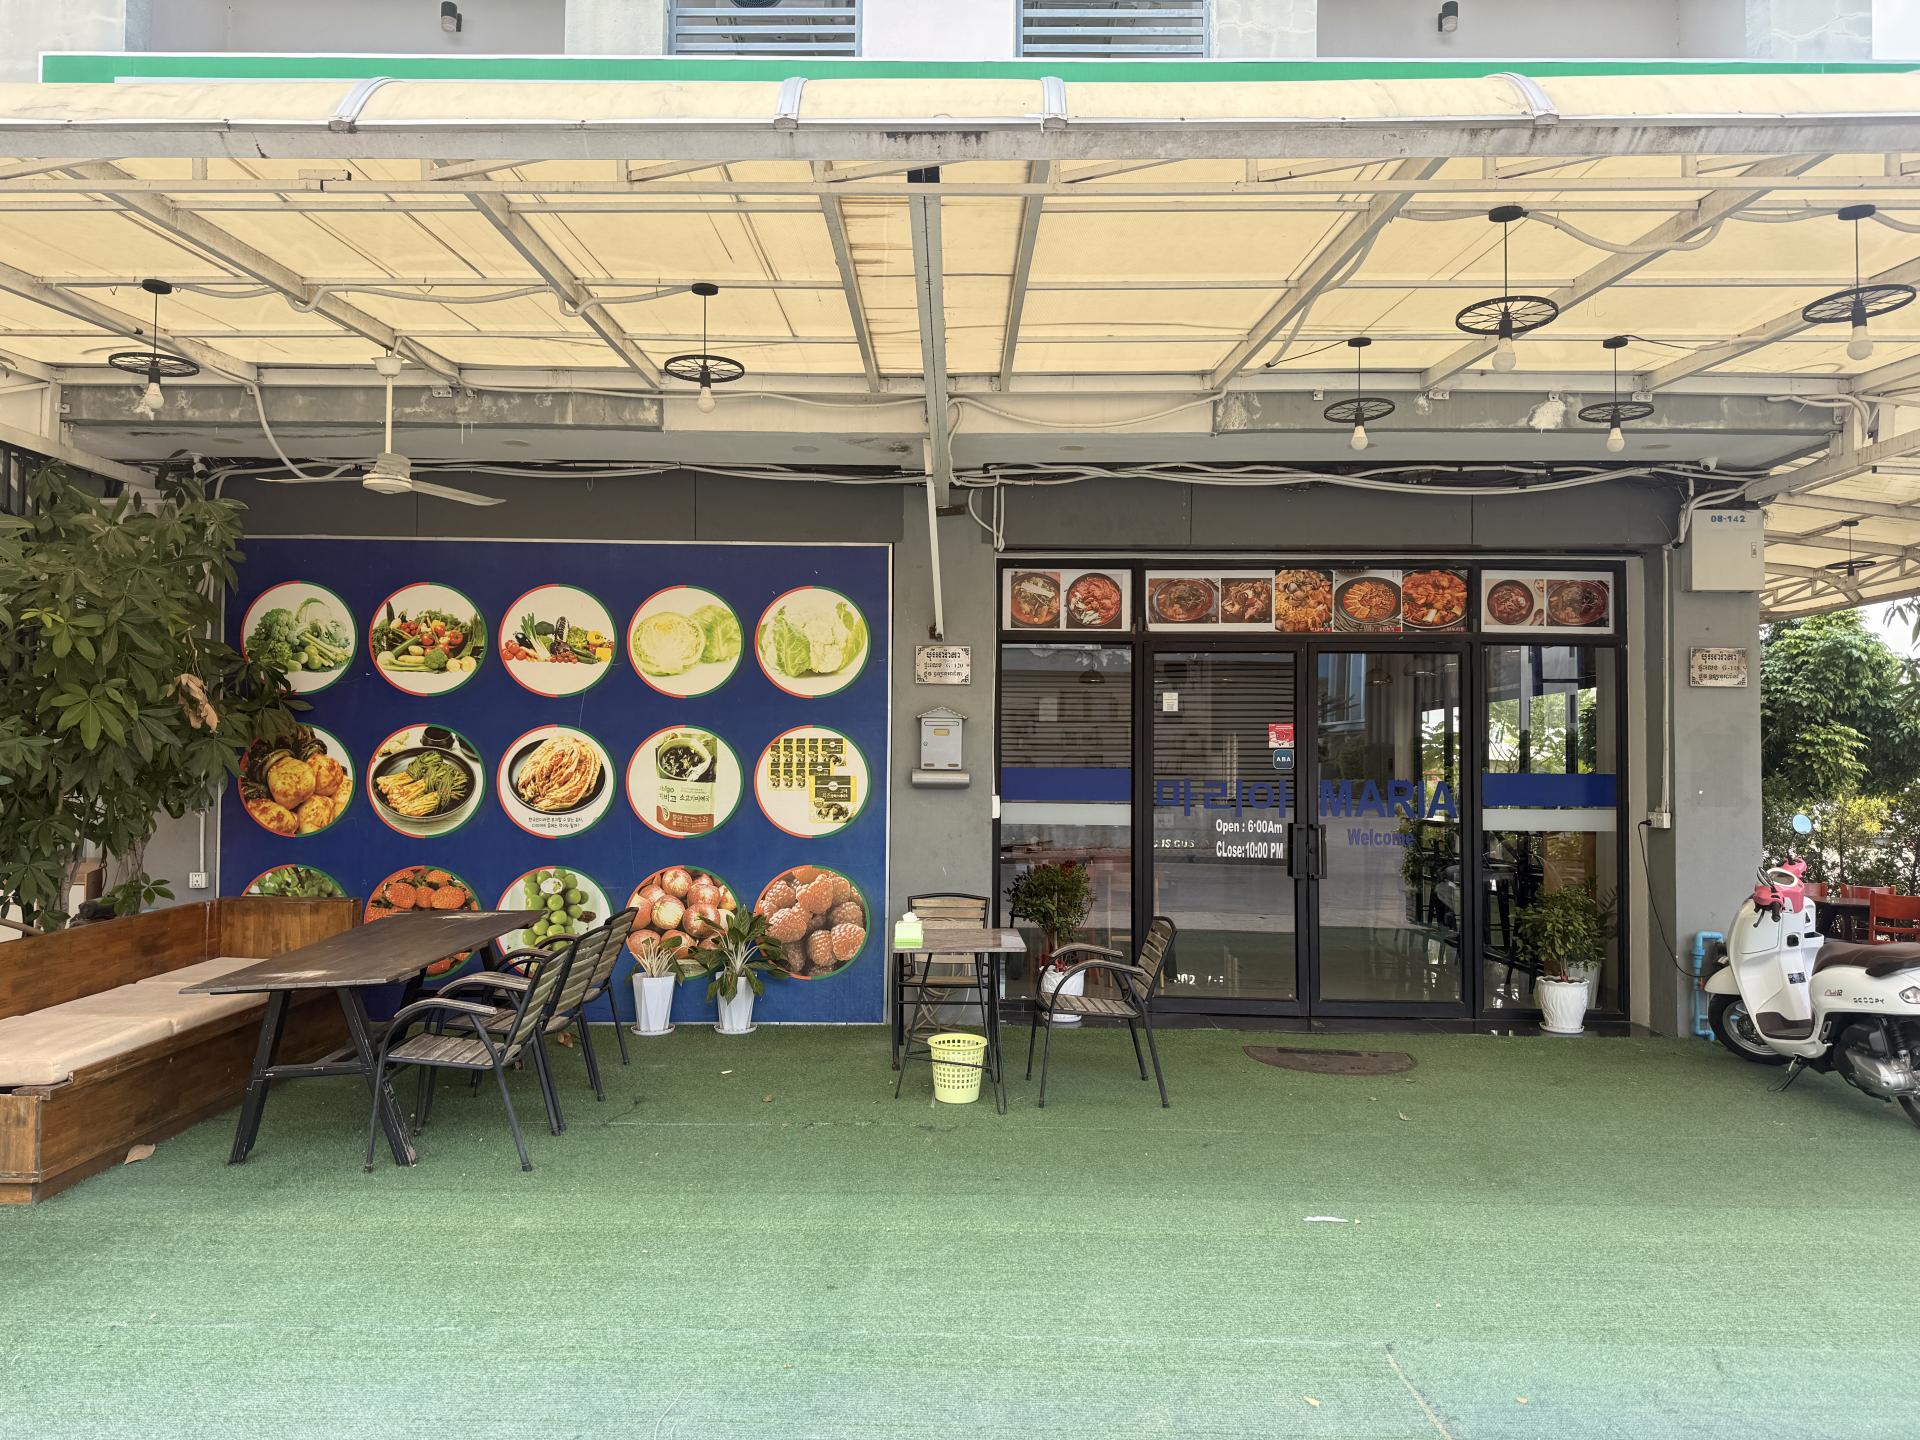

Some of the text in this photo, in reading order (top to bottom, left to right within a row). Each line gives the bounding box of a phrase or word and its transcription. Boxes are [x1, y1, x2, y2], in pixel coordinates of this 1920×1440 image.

[1711, 514, 1746, 523] 08-142
[1156, 778, 1287, 818] 마리아
[1319, 778, 1458, 819] MARIA
[1215, 818, 1240, 836] Open
[1346, 827, 1415, 847] Welcome
[1270, 842, 1284, 859] PM
